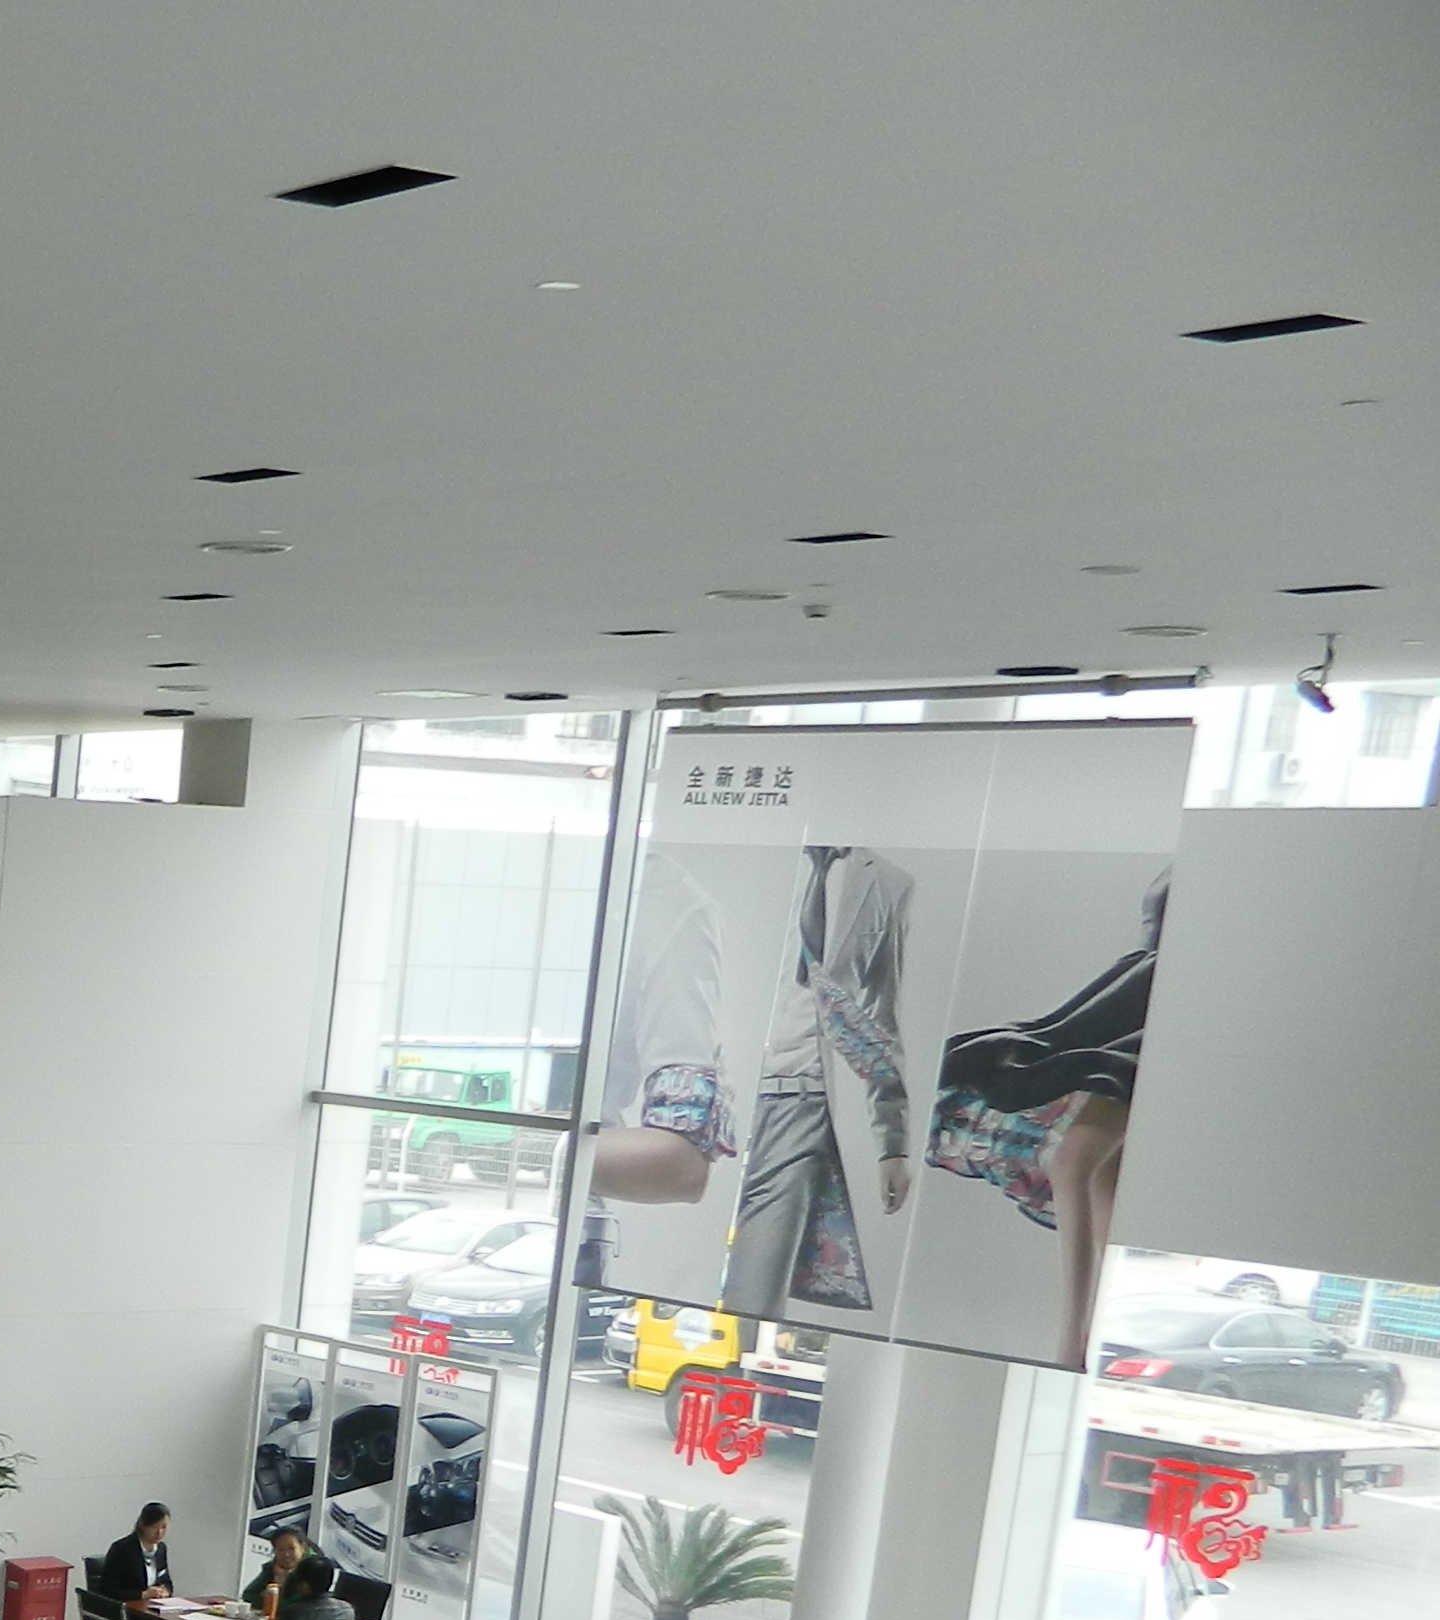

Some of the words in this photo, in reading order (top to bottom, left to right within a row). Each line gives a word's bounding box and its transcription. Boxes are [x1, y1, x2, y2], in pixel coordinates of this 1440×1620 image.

[682, 791, 708, 806] ALL
[711, 791, 746, 806] NEW
[748, 792, 789, 807] JETTA
[687, 765, 795, 788] 全新捷达
[675, 1371, 768, 1475] 福
[1146, 1457, 1269, 1580] 福
